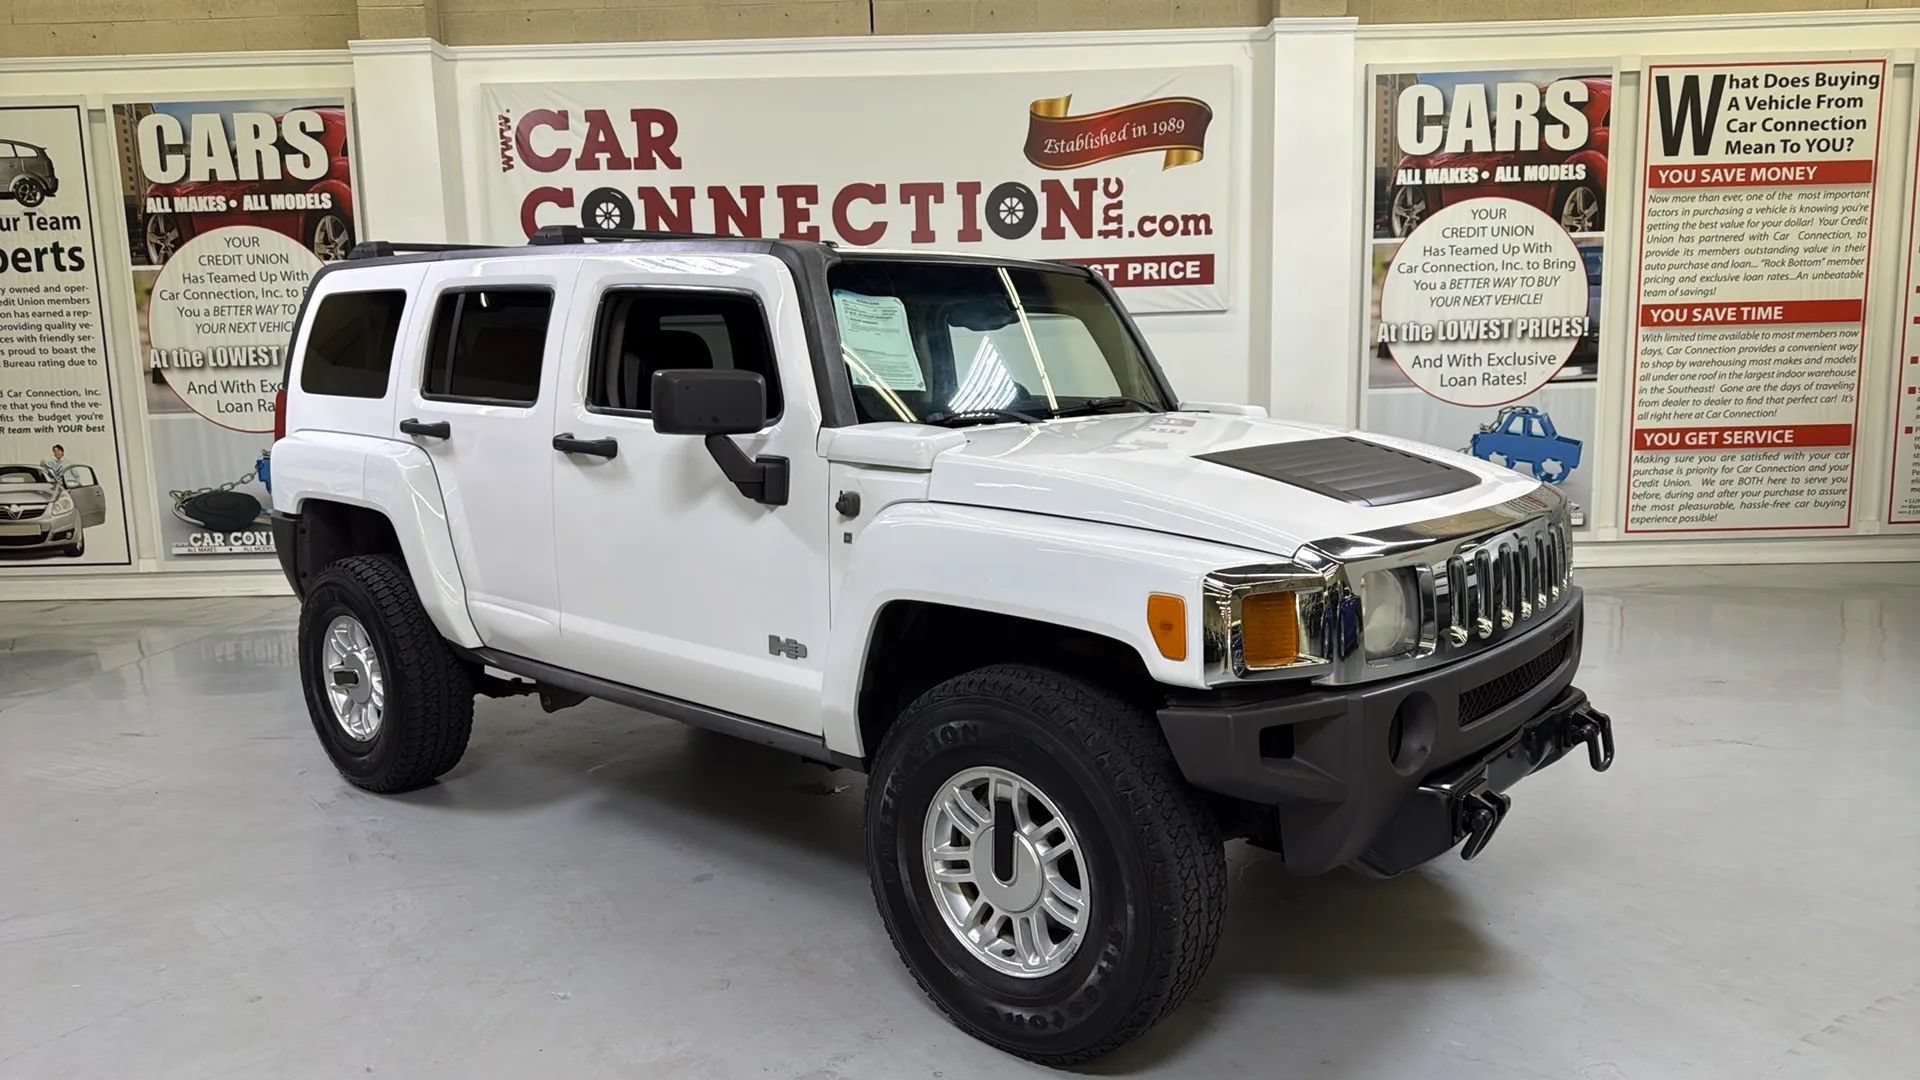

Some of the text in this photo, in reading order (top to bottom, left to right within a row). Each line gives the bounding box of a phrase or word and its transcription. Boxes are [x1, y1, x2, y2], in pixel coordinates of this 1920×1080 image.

[1764, 73, 1810, 88] Does
[1815, 72, 1880, 89] Buying
[1727, 94, 1864, 111] A Vehicle From
[1397, 79, 1589, 155] CARS
[1727, 116, 1867, 133] Car Connection
[498, 109, 514, 172] www.
[515, 108, 682, 173] CAR
[1043, 117, 1186, 154] Established in 1989
[137, 109, 329, 184] CARS
[1725, 137, 1855, 155] Mean To YOU?
[1396, 167, 1479, 185] ALL MAKES
[1494, 164, 1586, 182] ALL MODELS
[1658, 166, 1818, 184] YOU SAVE MONEY
[147, 195, 228, 214] ALL MAKES
[243, 192, 332, 211] ALL MODELS
[1648, 194, 1669, 203] Now
[1672, 195, 1696, 203] more
[1699, 194, 1720, 202] than
[1722, 194, 1743, 202] ever,
[1765, 191, 1776, 200] of
[1777, 192, 1792, 200] the
[1797, 191, 1821, 199] most
[1823, 190, 1870, 200] important
[520, 177, 1099, 246] CONNECTION
[1471, 208, 1507, 220] YOUR
[1647, 208, 1678, 217] factors
[1681, 208, 1690, 216] in
[1692, 206, 1744, 218] purchasing
[1756, 205, 1787, 214] vehicle
[1789, 205, 1797, 213] is
[1799, 204, 1839, 214] knowing
[1841, 204, 1869, 214] you're
[24, 212, 81, 231] Team
[1127, 213, 1213, 238] .com
[1442, 225, 1535, 239] CREDIT UNION
[224, 236, 260, 248] YOUR
[1423, 242, 1552, 257] Has Teamed Up With
[198, 253, 289, 266] CREDIT UNION
[1397, 258, 1576, 274] Car Connection, Inc. to Bring
[182, 270, 309, 285] Has Teamed Up With
[1127, 261, 1200, 280] PRICE
[1414, 276, 1560, 291] You a BETTER WAY TO BUY
[160, 290, 181, 301] Car
[183, 288, 258, 300] Connection,
[262, 288, 283, 299] Inc.
[286, 288, 298, 298] to
[1429, 293, 1543, 308] YOUR NEXT VEHICLE!
[177, 304, 297, 318] You a BETTER WAY TO
[1650, 306, 1783, 322] YOU SAVE TIME
[196, 323, 226, 334] YOUR
[228, 322, 257, 334] NEXT
[1378, 316, 1590, 343] At the LOWEST PRICES!
[16, 333, 75, 344] with friendly
[8, 345, 96, 358] proud to boast the
[150, 346, 279, 369] At the LOWEST
[4, 358, 98, 368] Bureau rating due to
[1412, 352, 1557, 369] And With Exclusive
[187, 380, 217, 395] And
[220, 380, 256, 394] With
[1440, 372, 1527, 388] Loan Rates!
[1638, 381, 1855, 394] in the Southeast! Gone are the days of traveling
[7, 388, 101, 398] Car Connection, Inc.
[217, 400, 253, 414] Loan
[8, 424, 106, 434] team with YOUR best
[1644, 430, 1794, 446] YOU GET SERVICE
[1632, 463, 1850, 478] purchase is priority for Car Connection and your
[1630, 514, 1718, 525] experience possible!
[189, 533, 225, 547] CAR
